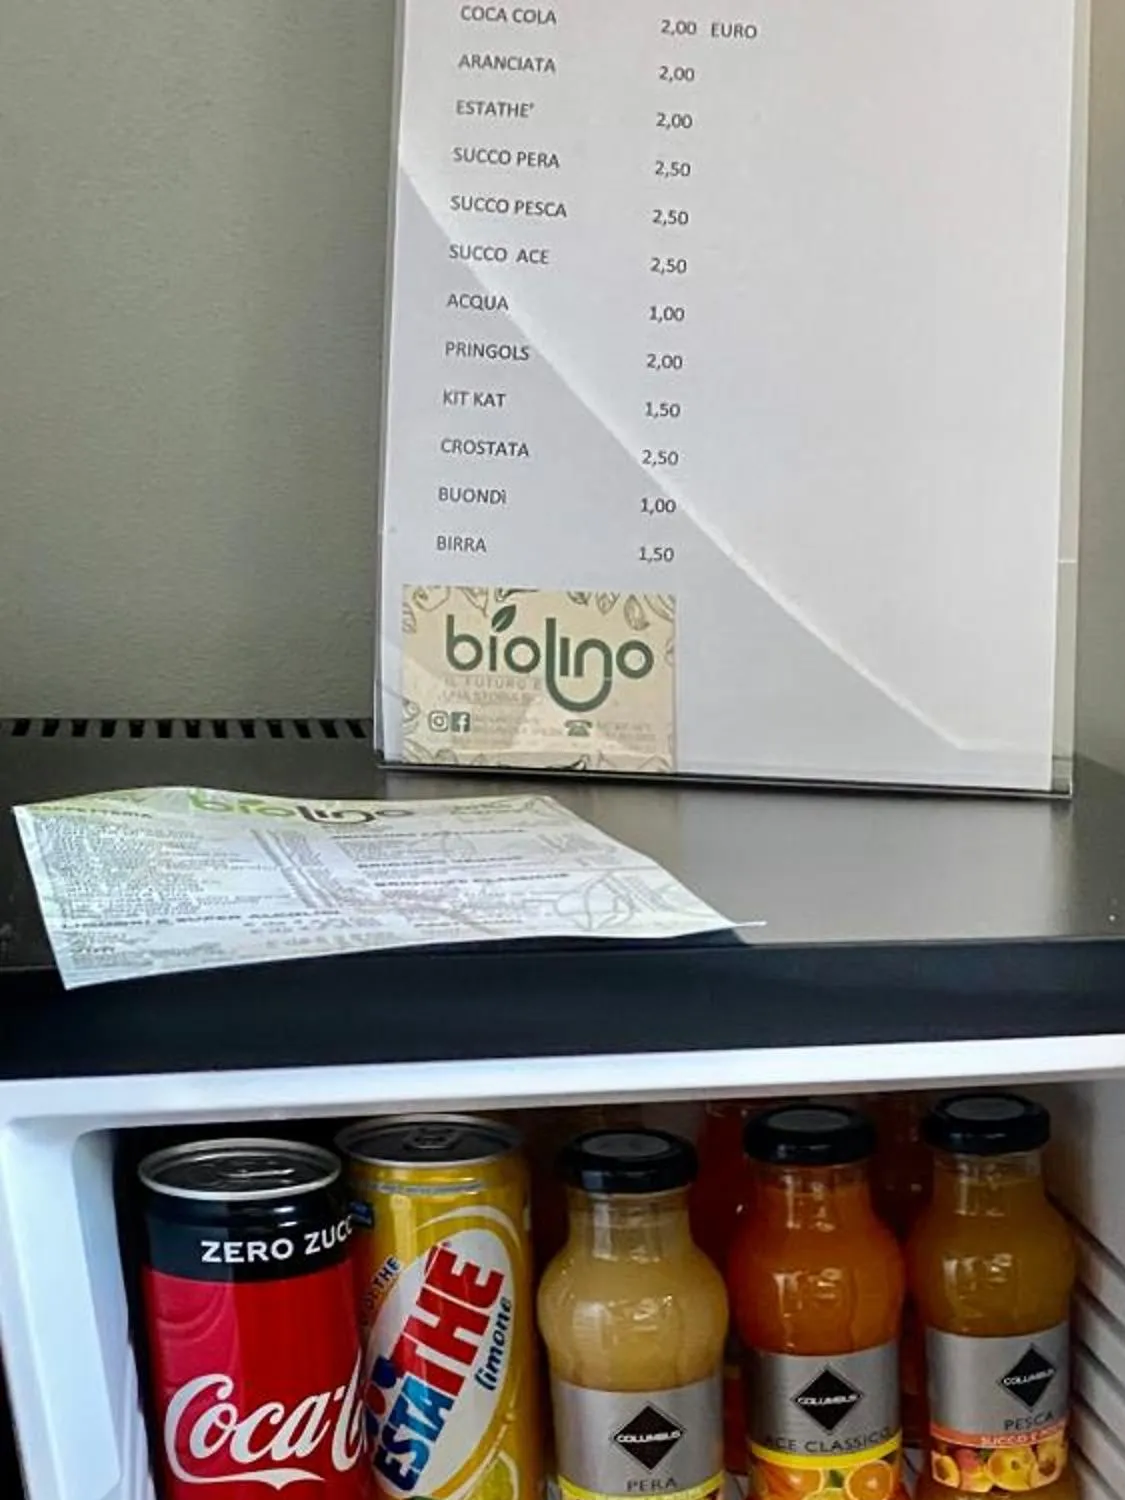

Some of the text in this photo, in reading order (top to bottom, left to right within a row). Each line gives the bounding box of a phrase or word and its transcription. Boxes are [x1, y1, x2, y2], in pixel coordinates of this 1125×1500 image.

[460, 5, 758, 39] COCA COLA 2,00 EURO
[457, 54, 695, 83] ARANCIATA 2,00
[655, 111, 693, 131] 2,00
[453, 146, 691, 178] SUCCO PERA 2,50
[450, 195, 689, 227] SUCCO PESCA 2,50
[449, 244, 687, 275] SUCCO ACE 2,50
[446, 293, 685, 324] ACQUA 1,00
[445, 341, 683, 371] PRINGOLS 2,00
[442, 389, 681, 419] KIT KAT 1,50
[440, 438, 679, 467] CROSTATA 2,50
[641, 497, 677, 516] 1,00
[436, 535, 675, 564] BIRRA 1,50
[446, 606, 654, 712] biolino
[201, 1238, 294, 1263] ZERO
[474, 1295, 513, 1391] limone
[797, 1394, 858, 1406] COLUMBUS
[1004, 1411, 1054, 1431] PESCA
[616, 1430, 682, 1443] COLUMBUS
[626, 1477, 678, 1492] PERA
